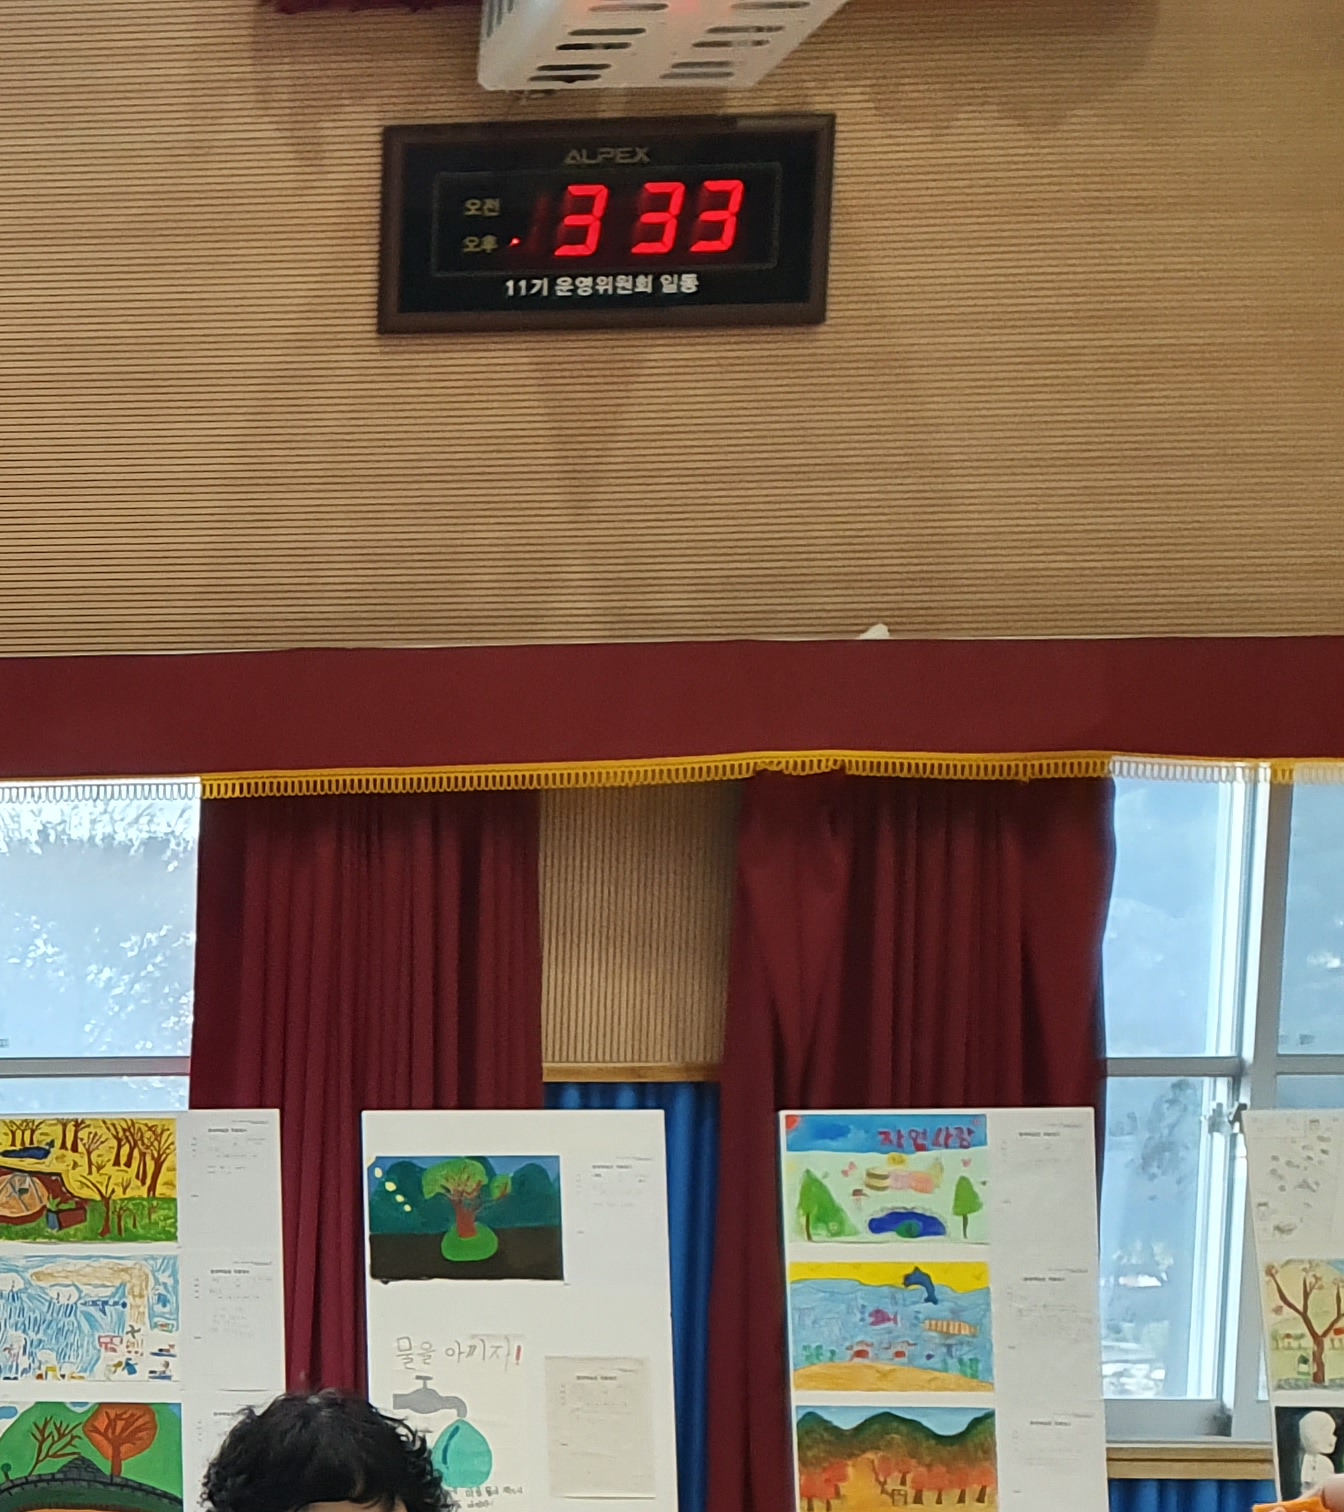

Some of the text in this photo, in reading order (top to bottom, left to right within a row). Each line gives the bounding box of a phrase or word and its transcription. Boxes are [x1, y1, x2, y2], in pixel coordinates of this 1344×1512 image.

[564, 147, 651, 165] ALPEX
[463, 199, 501, 217] 오전
[462, 235, 499, 253] 오후
[505, 274, 699, 297] 11기 운영위원회 일동
[396, 1336, 436, 1370] 물을
